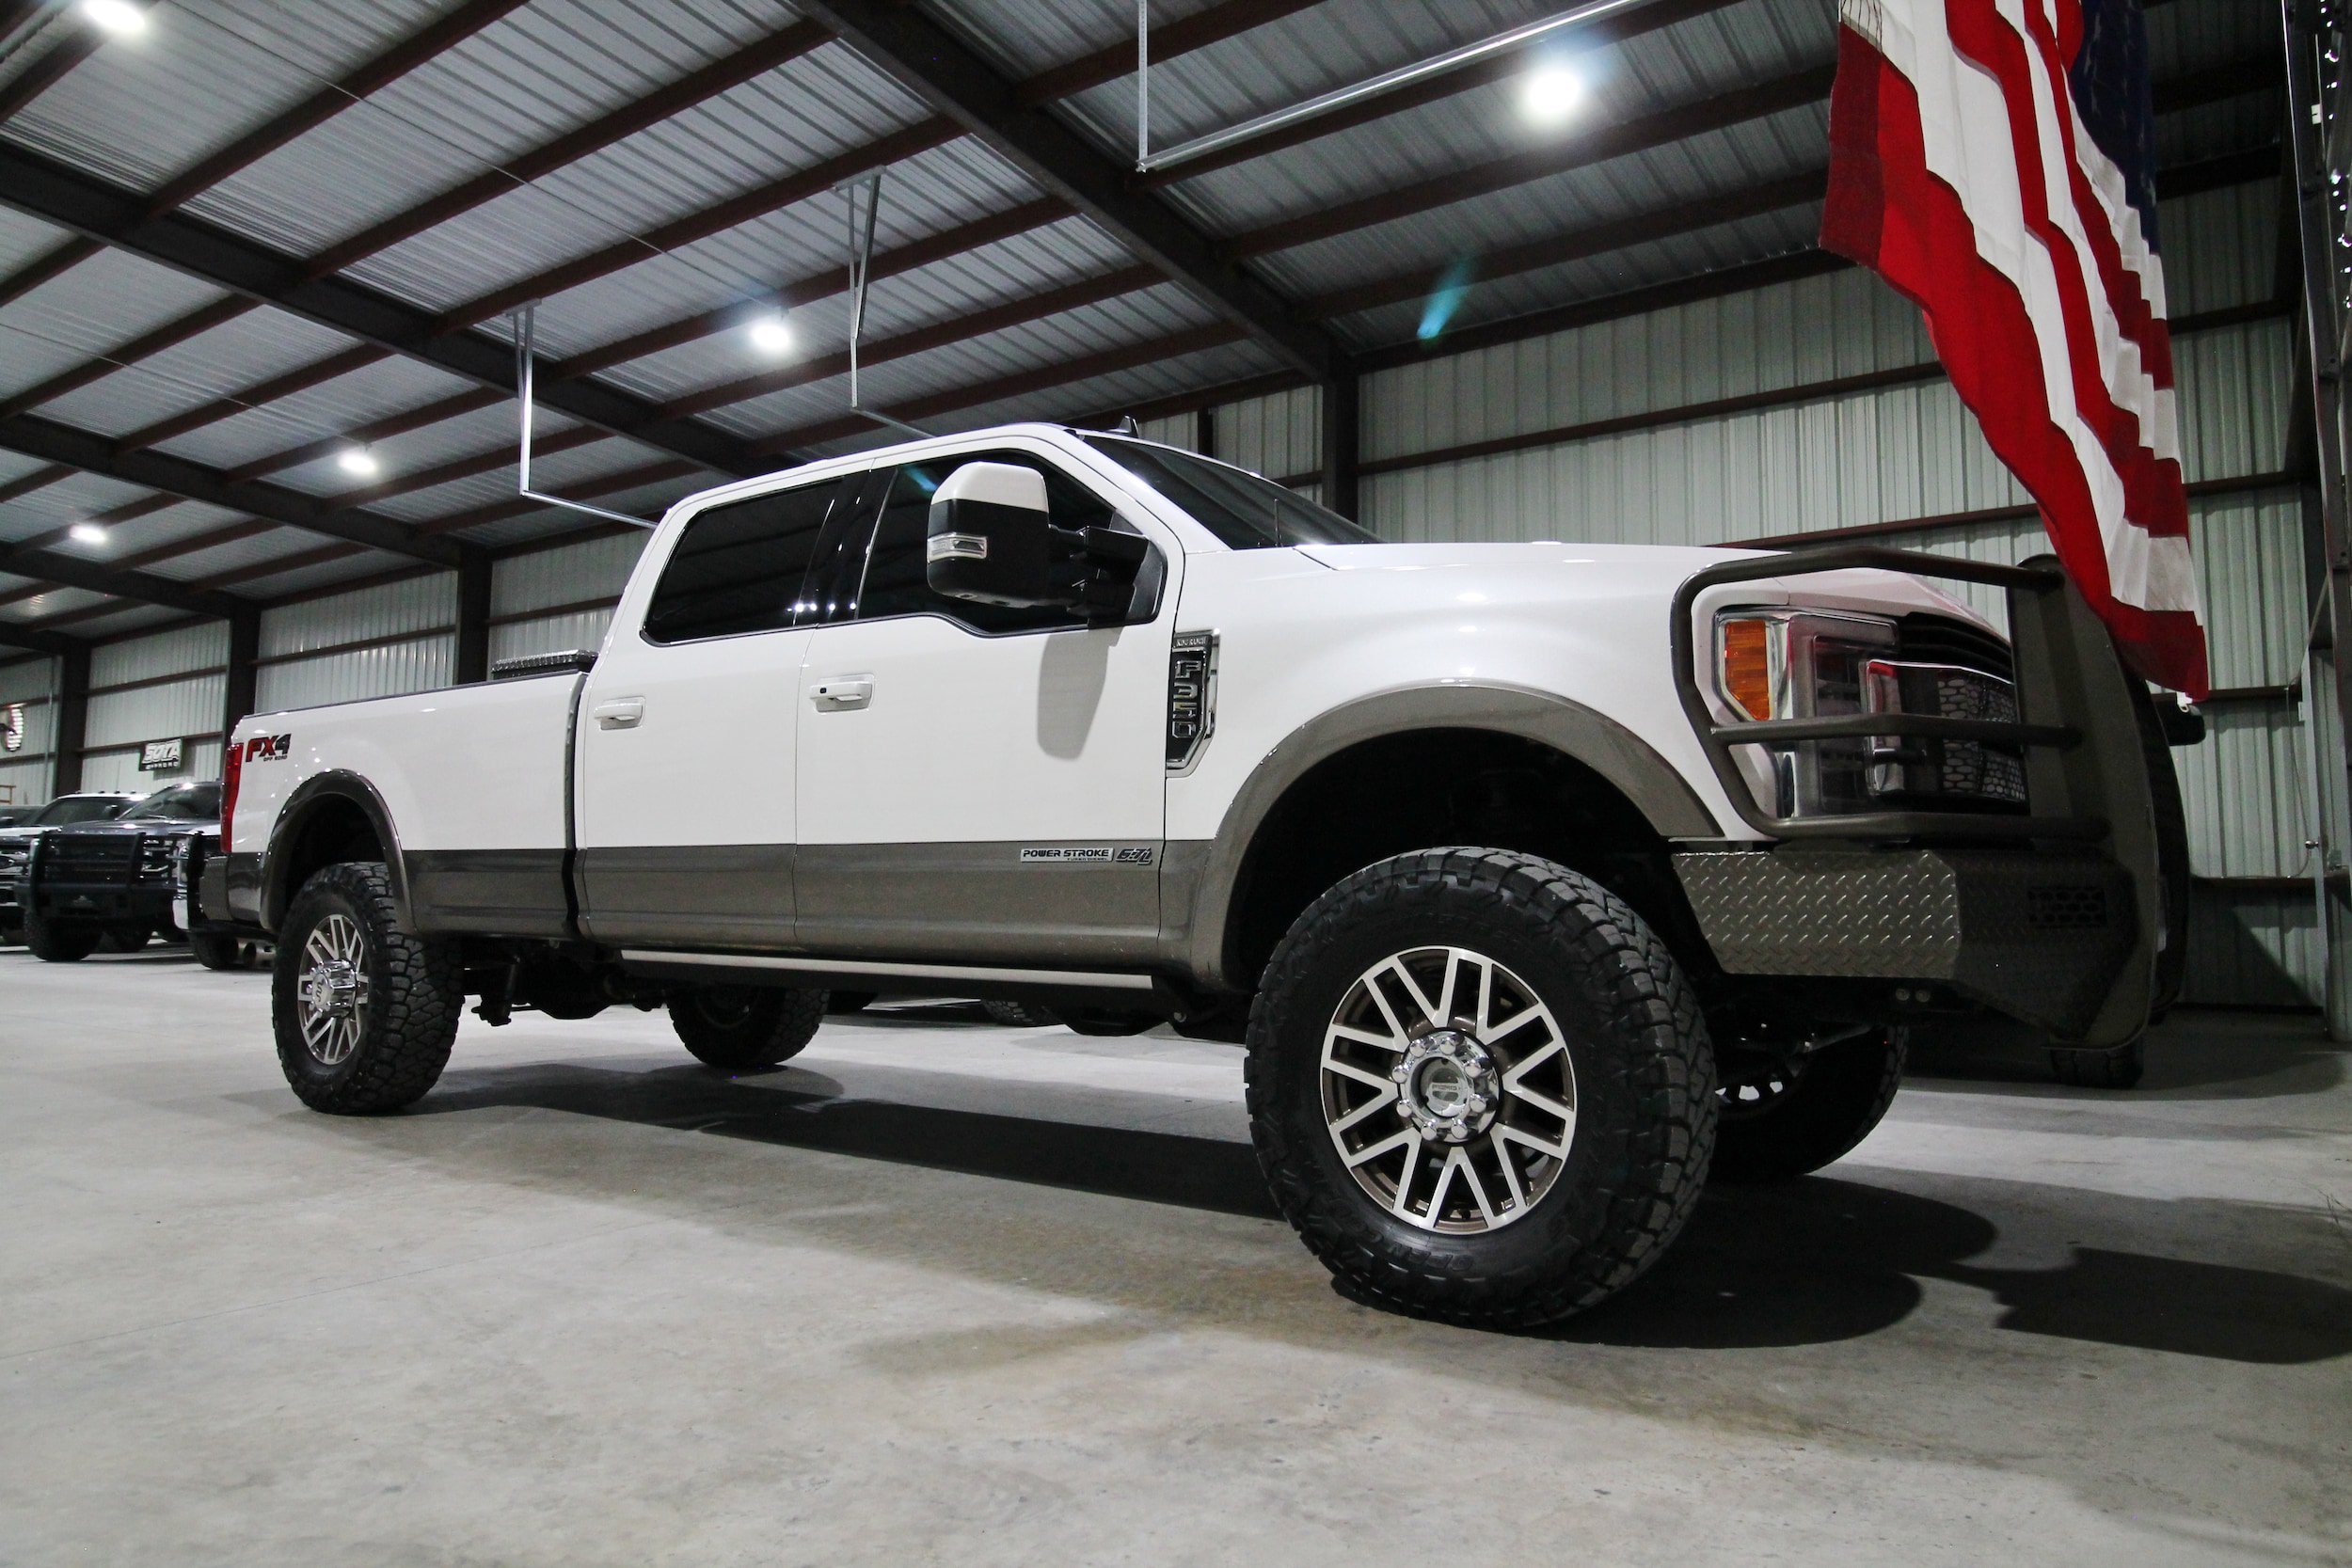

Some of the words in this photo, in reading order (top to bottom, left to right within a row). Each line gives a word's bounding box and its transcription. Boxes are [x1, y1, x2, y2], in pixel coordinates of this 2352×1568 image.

[1172, 659, 1202, 738] F350
[246, 733, 292, 763] FX4
[1023, 849, 1061, 858] POWER
[1063, 848, 1109, 858] STROKE
